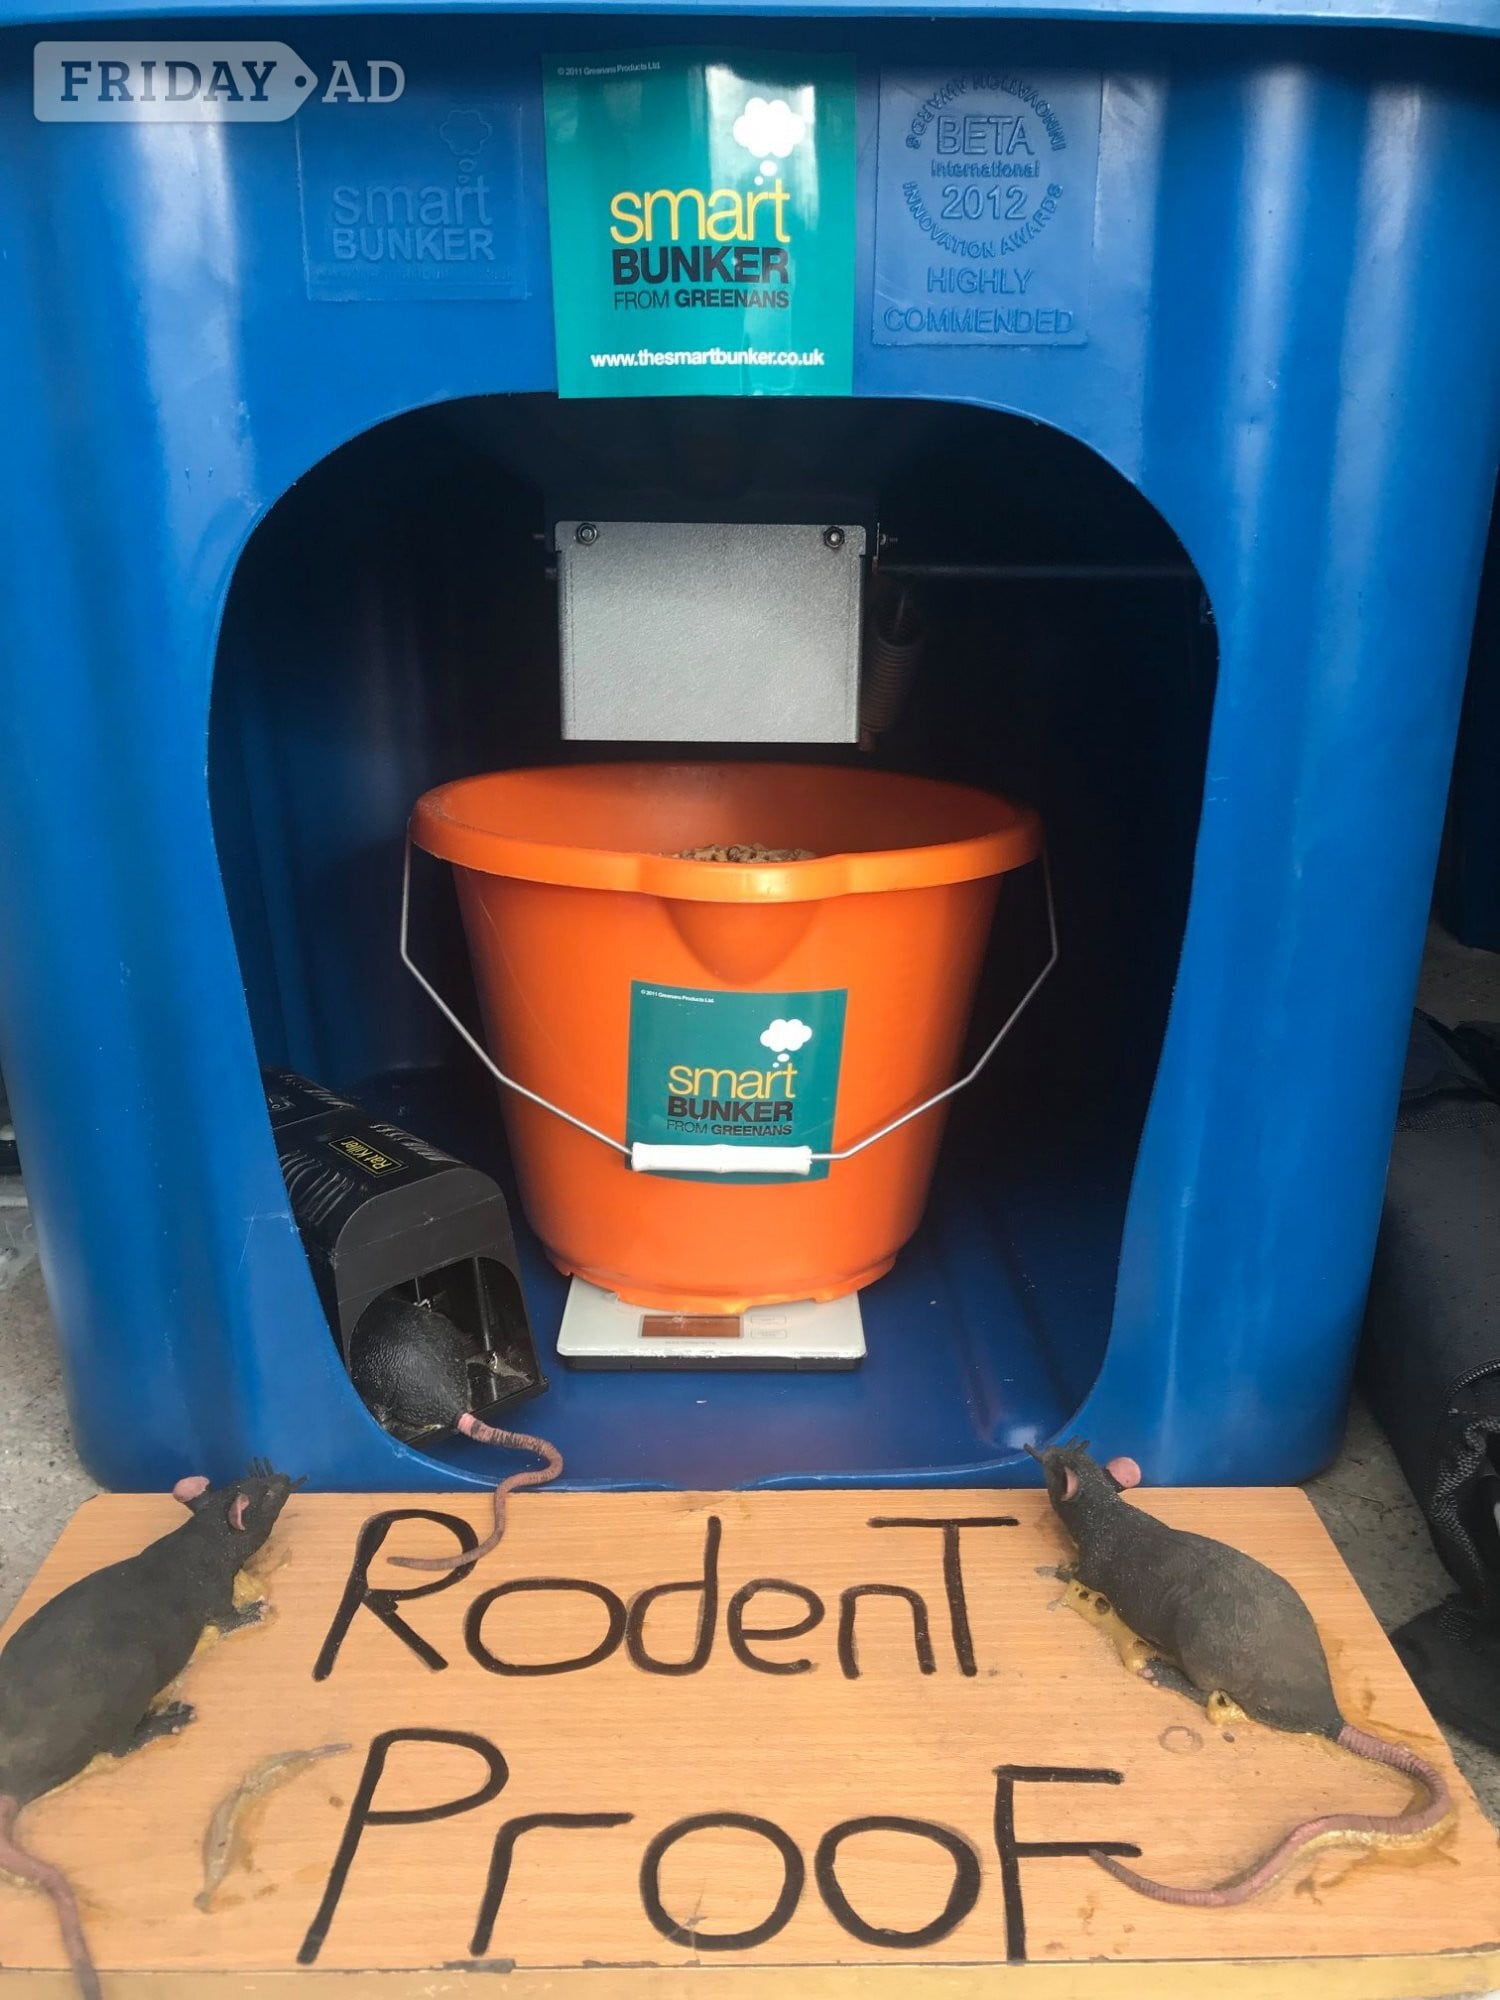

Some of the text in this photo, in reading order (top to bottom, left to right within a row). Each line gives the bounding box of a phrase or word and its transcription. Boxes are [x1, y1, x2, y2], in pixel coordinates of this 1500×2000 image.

[936, 115, 1035, 155] BETA
[931, 159, 1040, 178] International
[332, 174, 493, 226] smart
[610, 178, 791, 244] smart
[941, 184, 1028, 220] 2012
[903, 181, 1064, 259] INNOVATION AWARDS
[332, 228, 496, 262] BUNKER
[612, 245, 789, 285] BUNKER
[926, 266, 1035, 294] HIGHLY
[614, 289, 789, 310] FROM GREENANS
[883, 306, 1073, 335] COMMENDED
[591, 347, 825, 369] www.thesmartbunker.co.uk
[668, 1062, 797, 1100] smart
[667, 1095, 794, 1122] BUNKER
[666, 1119, 792, 1137] FROM GREENANS
[340, 1140, 392, 1170] Rat Killer
